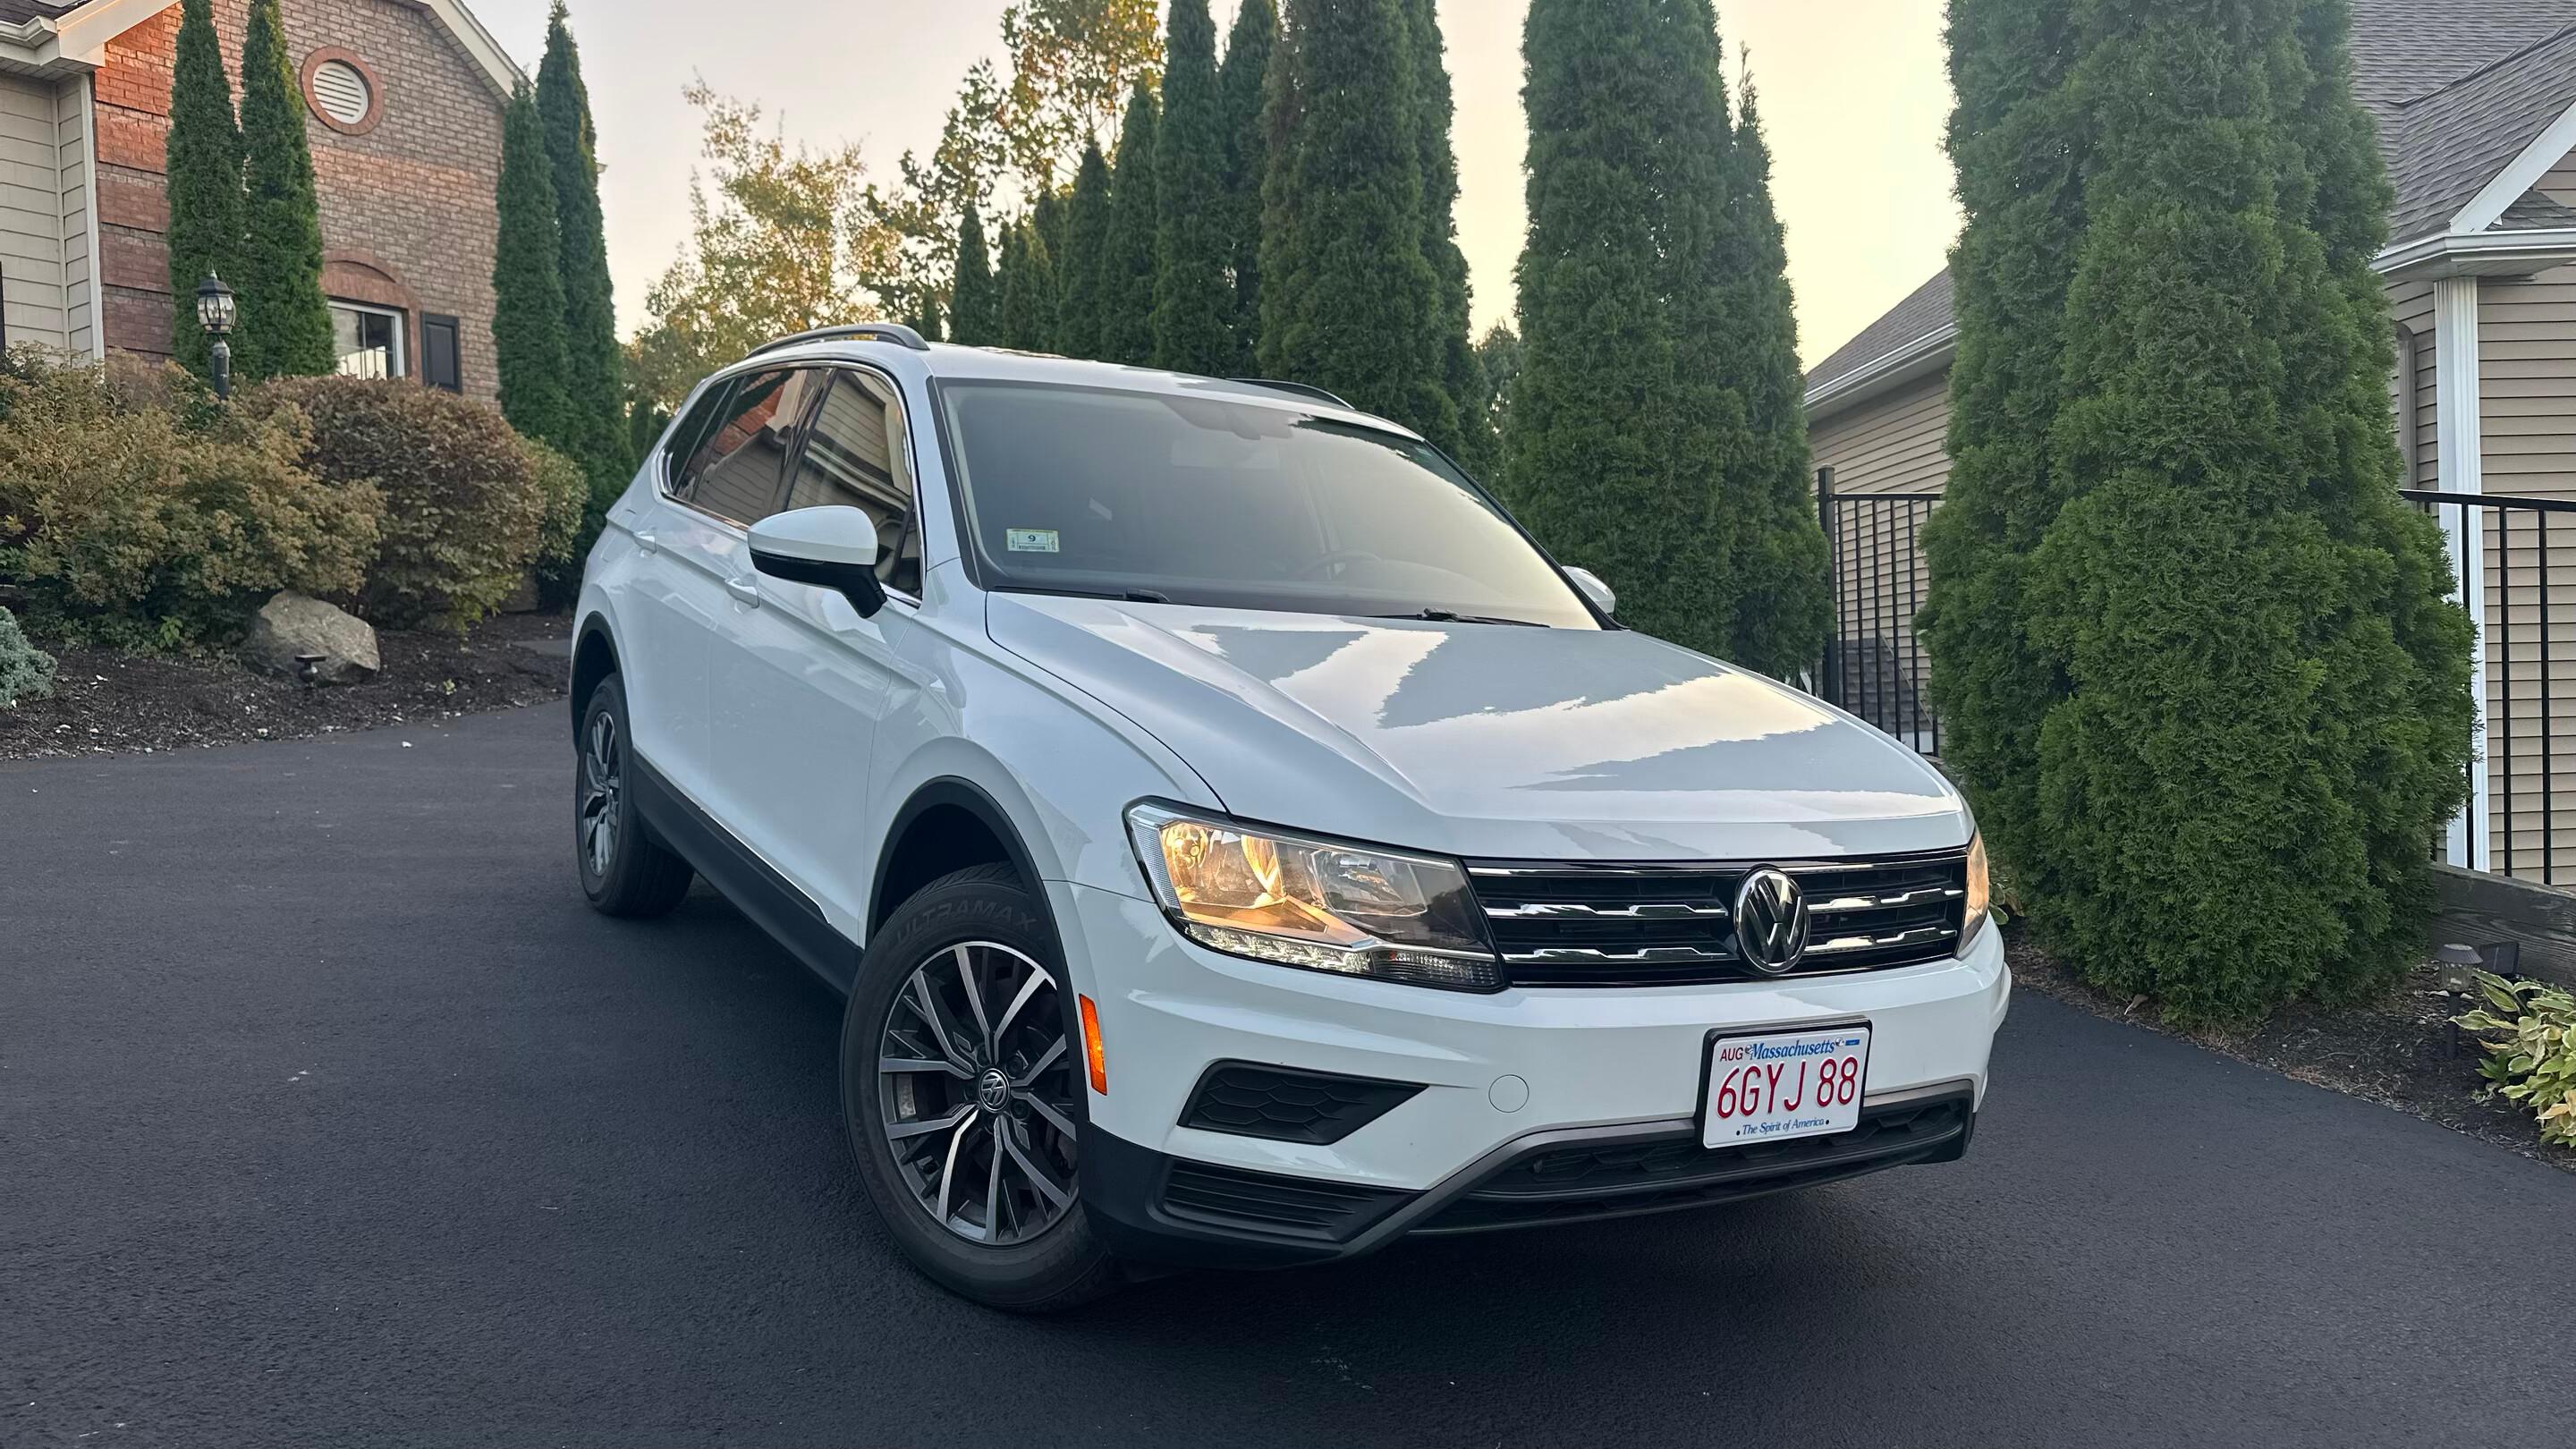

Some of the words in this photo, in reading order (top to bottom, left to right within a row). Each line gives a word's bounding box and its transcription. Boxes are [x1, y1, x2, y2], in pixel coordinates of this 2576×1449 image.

[1028, 534, 1037, 542] 9
[897, 899, 1038, 942] ULTRAMAX
[1720, 1046, 1744, 1062] AUG
[1749, 1039, 1835, 1061] Massachusetts
[1716, 1060, 1807, 1119] 6GYJ
[1816, 1056, 1859, 1107] 88
[1742, 1123, 1757, 1136] The
[1759, 1121, 1781, 1134] Spirit
[1783, 1120, 1792, 1131] of
[1792, 1117, 1825, 1129] America
